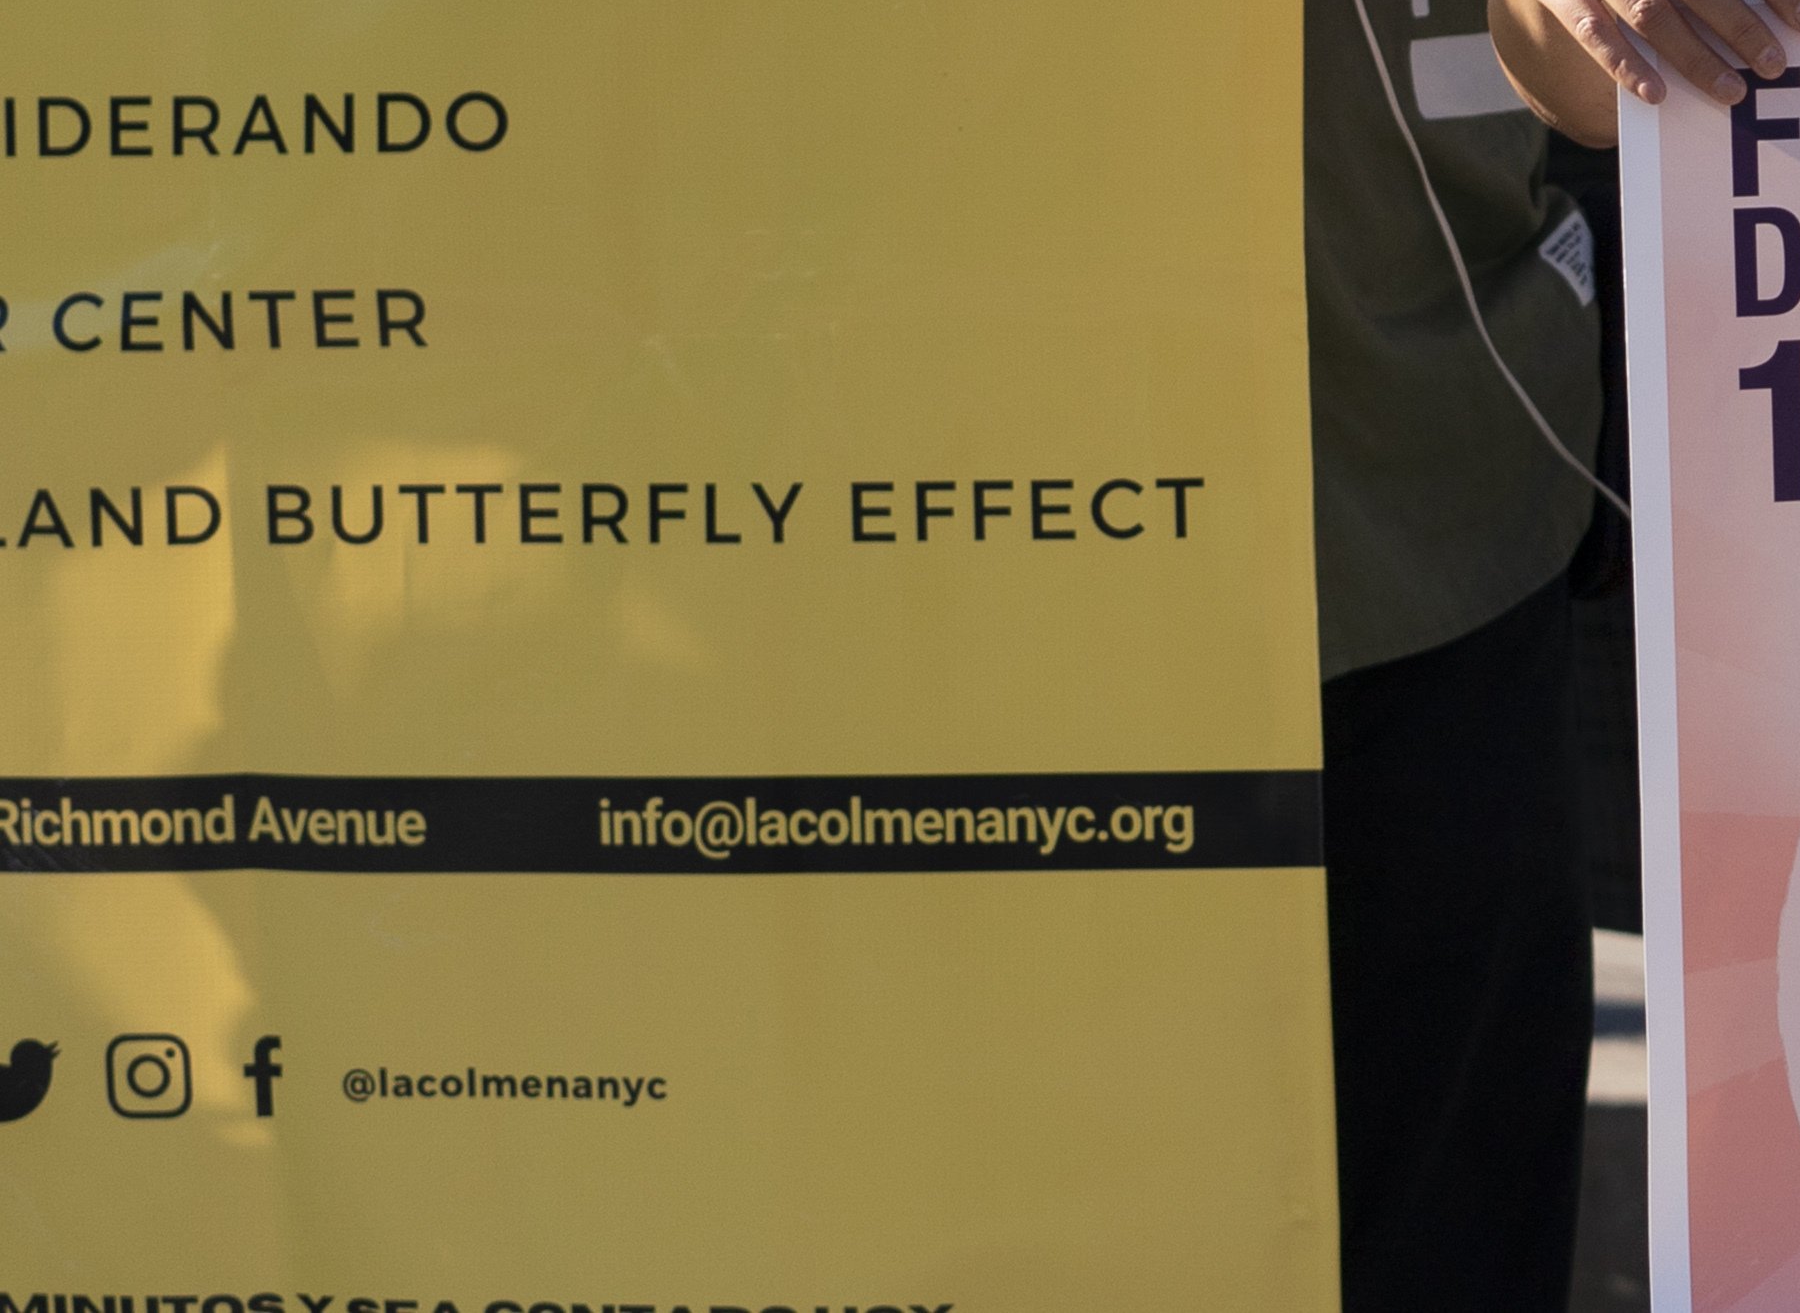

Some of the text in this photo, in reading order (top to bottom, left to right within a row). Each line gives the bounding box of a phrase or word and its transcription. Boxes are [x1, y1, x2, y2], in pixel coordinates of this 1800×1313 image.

[4, 92, 509, 158] IDERANDO
[52, 289, 430, 353] CENTER
[0, 476, 1205, 548] AND BUTTERFLY EFFECT
[0, 794, 1195, 861] Richmond Avenue info@lacolmenanyc.org
[341, 1066, 669, 1108] @lacolmenanyc
